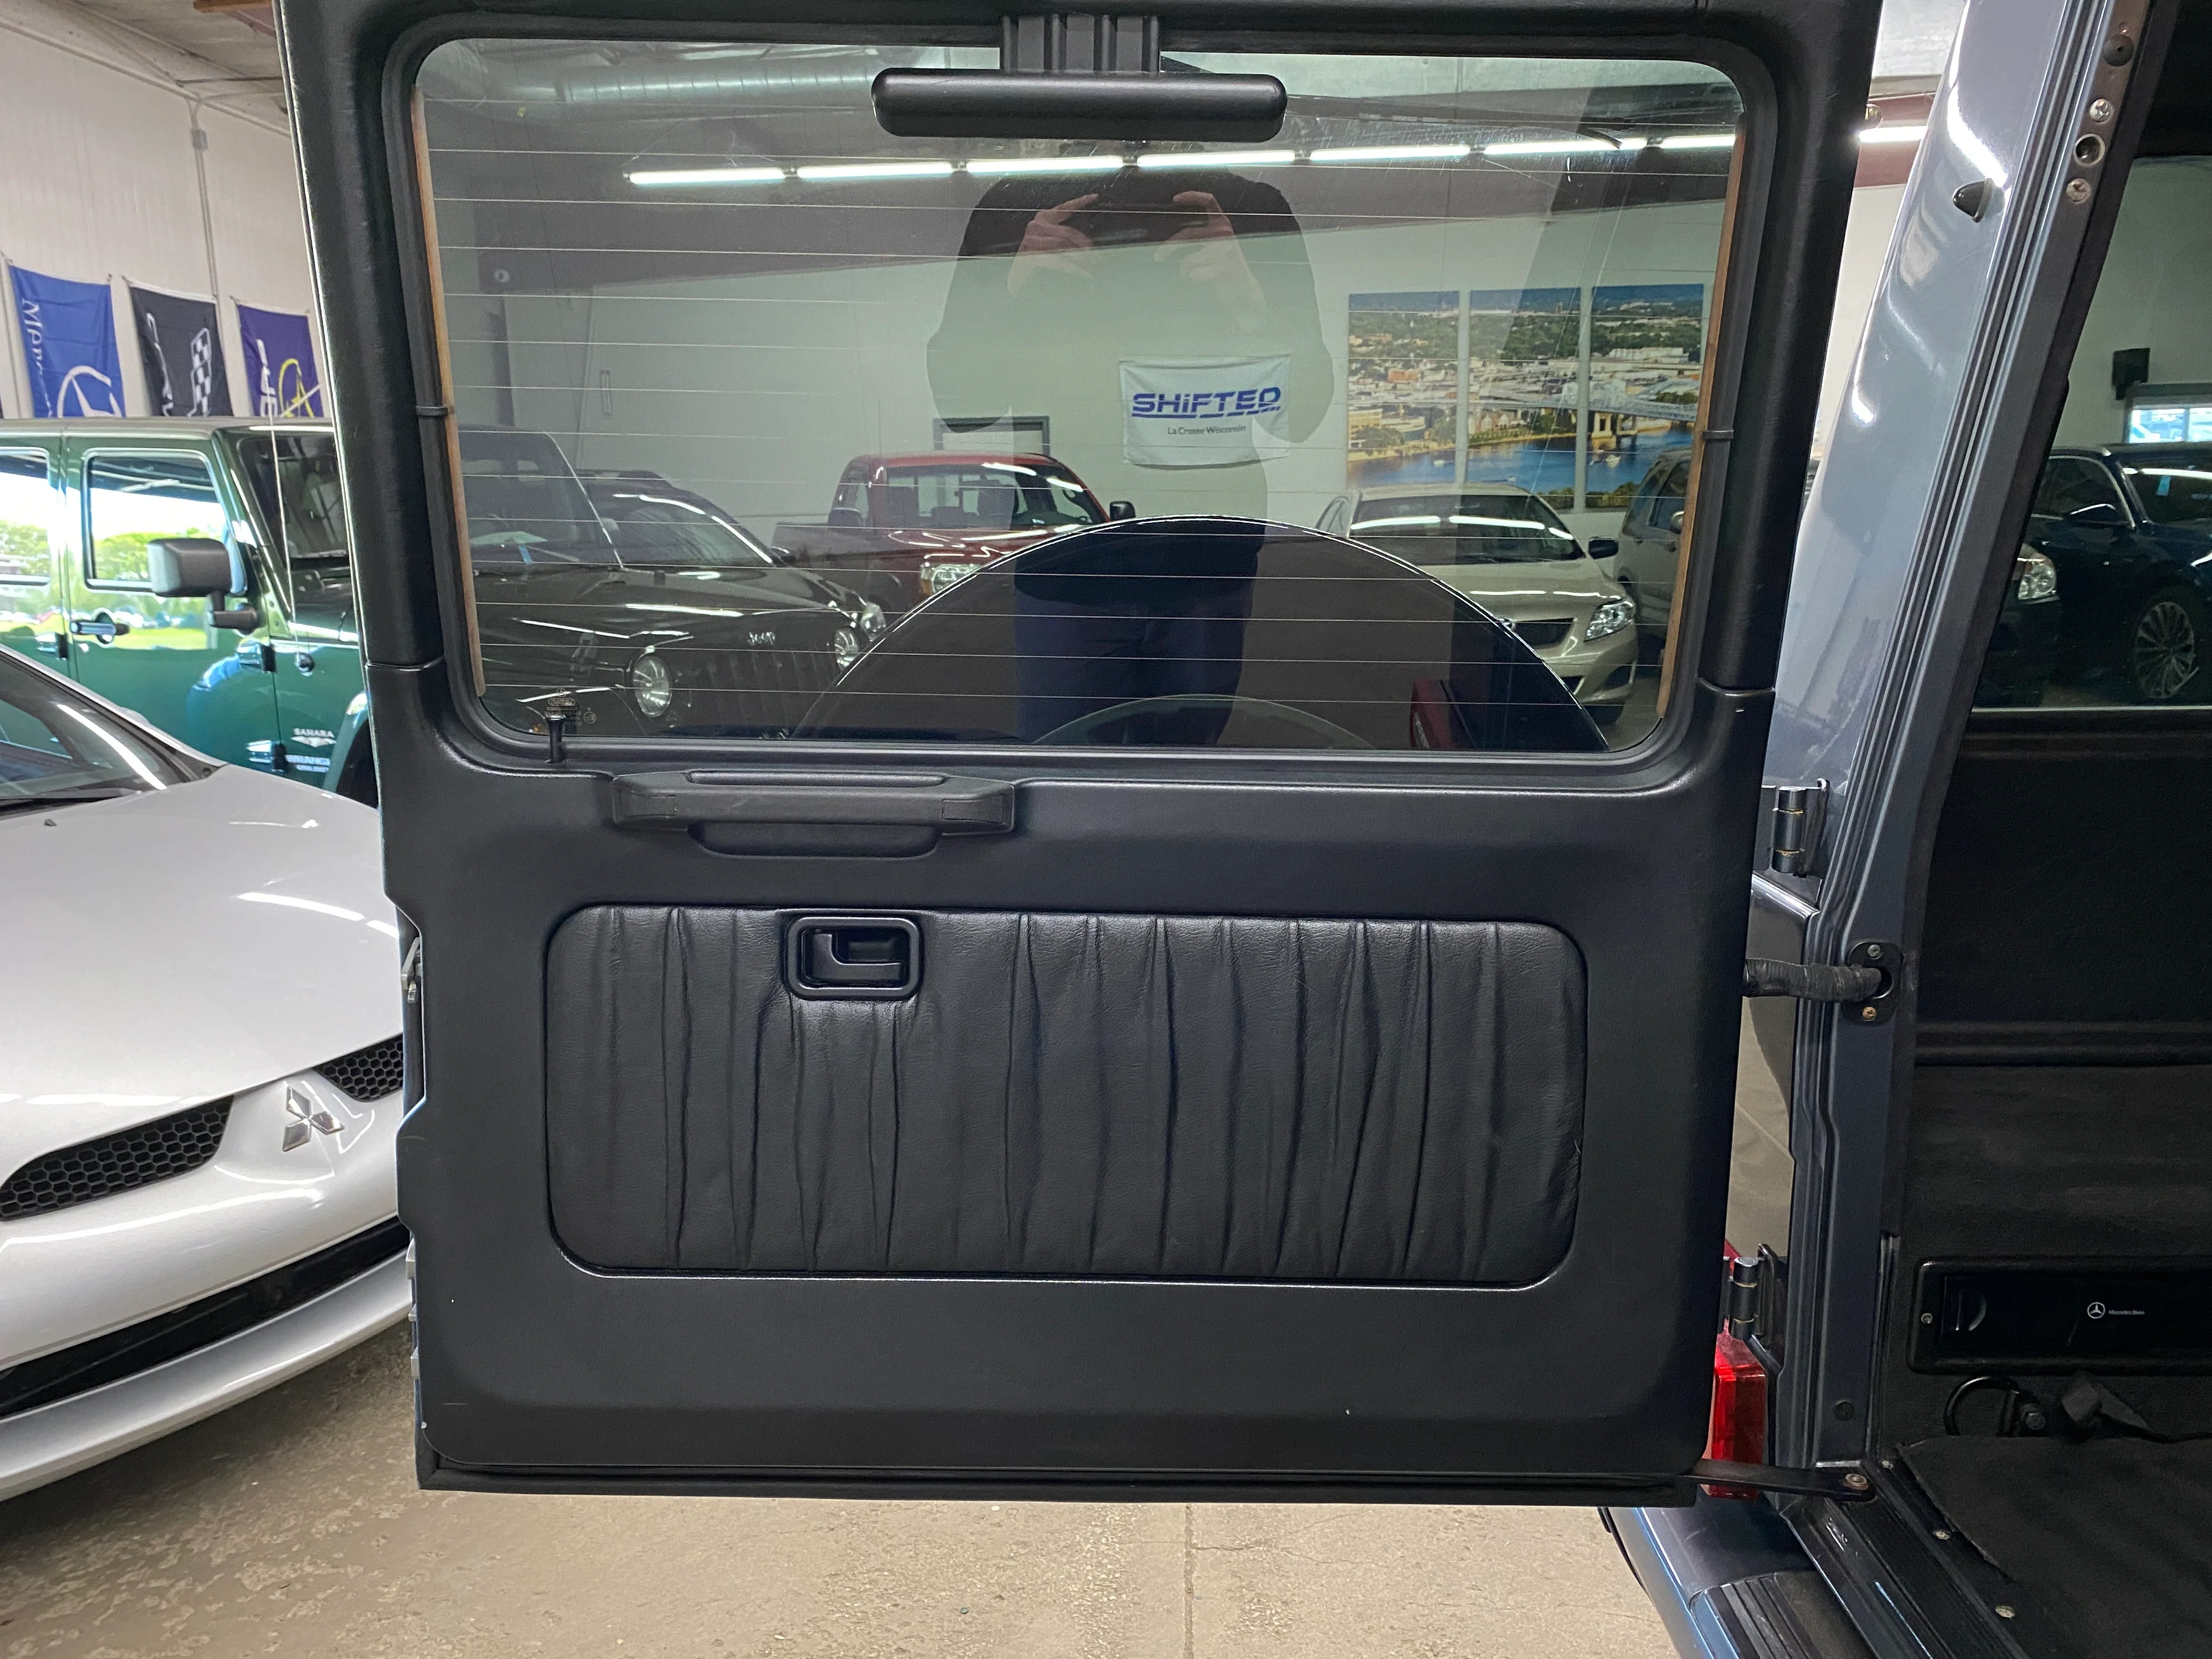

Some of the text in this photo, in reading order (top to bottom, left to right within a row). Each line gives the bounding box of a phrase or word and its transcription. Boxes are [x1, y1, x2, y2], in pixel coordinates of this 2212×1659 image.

[1206, 425, 1246, 433] Wisconsin
[748, 631, 776, 646] Jeep
[294, 728, 335, 738] SAHARA
